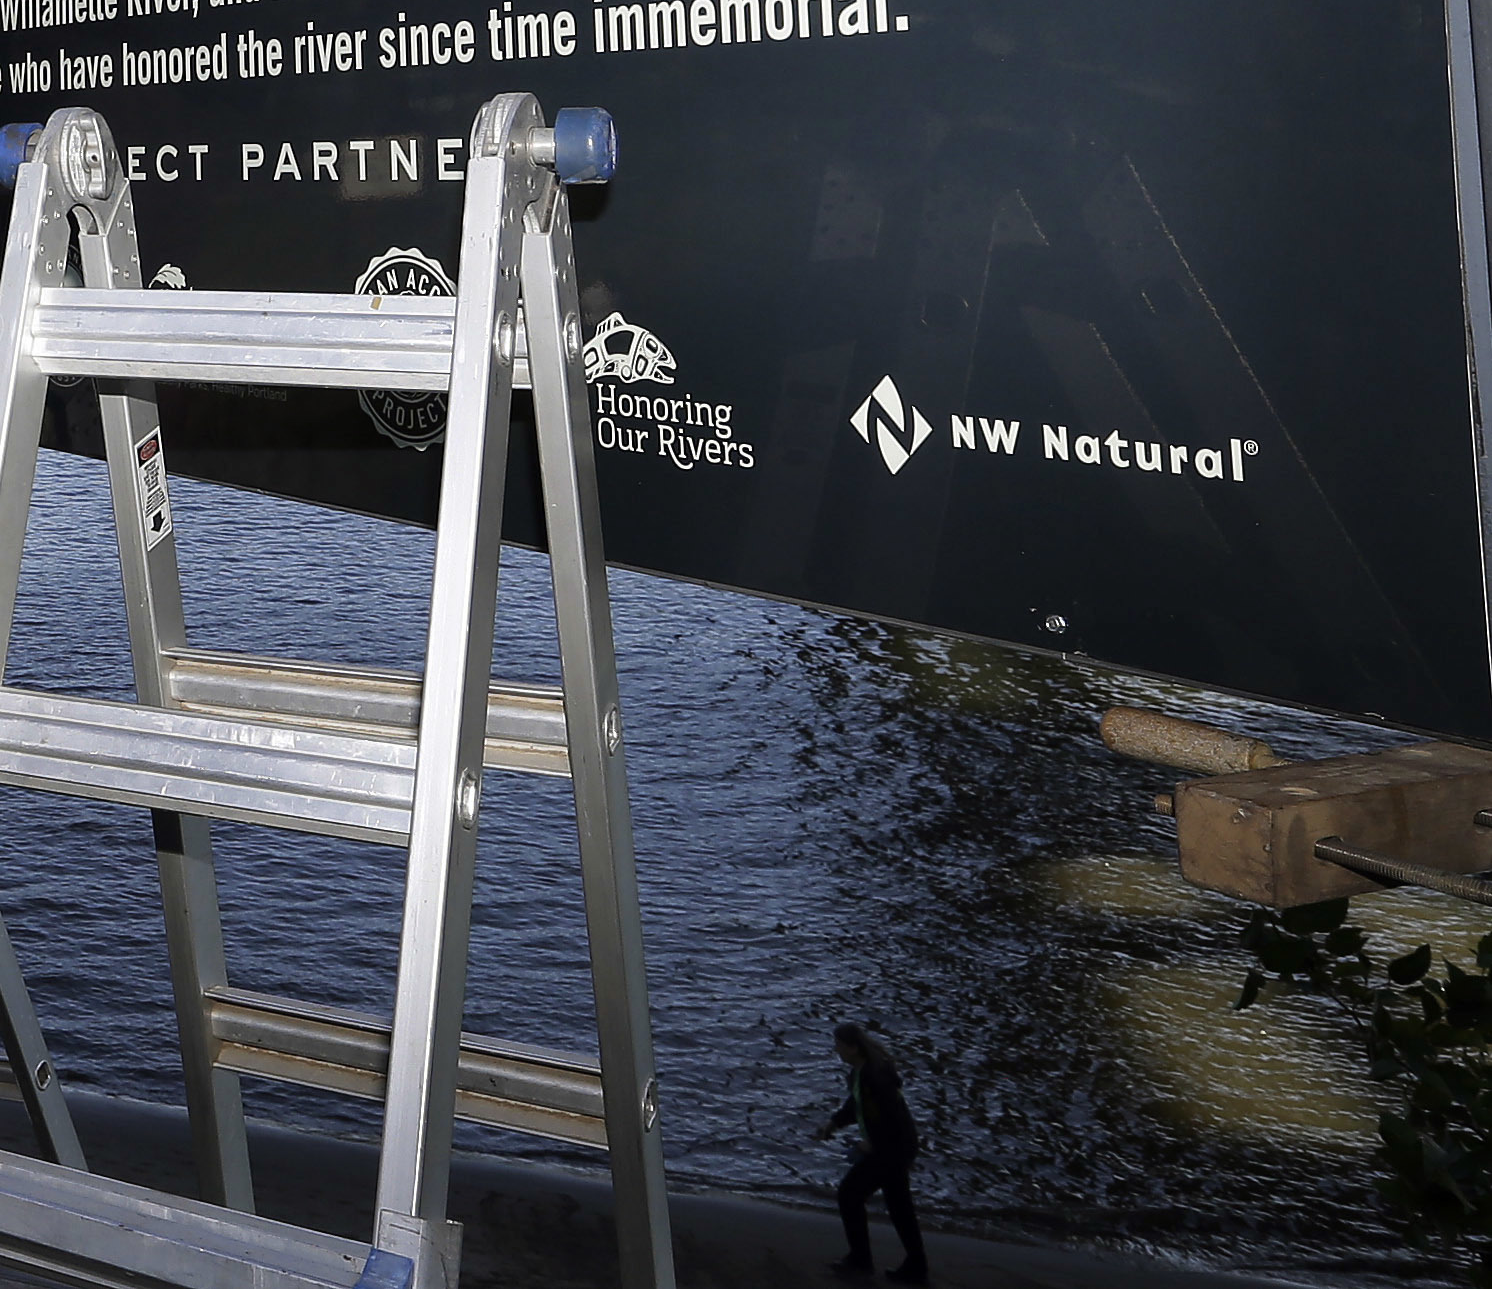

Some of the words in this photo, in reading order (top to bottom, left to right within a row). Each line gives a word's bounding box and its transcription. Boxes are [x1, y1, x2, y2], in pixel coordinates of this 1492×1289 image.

[8, 52, 51, 94] who
[59, 48, 113, 91] have
[122, 32, 228, 86] honored
[236, 29, 283, 79] the
[294, 21, 367, 74] river
[379, 12, 475, 69] since
[487, 1, 576, 61] time
[242, 138, 464, 182] PARTNE
[248, 385, 288, 402] Portland
[595, 382, 732, 439] Honoring
[597, 417, 649, 453] Our
[657, 424, 754, 470] Rivers
[951, 414, 1020, 455] NW
